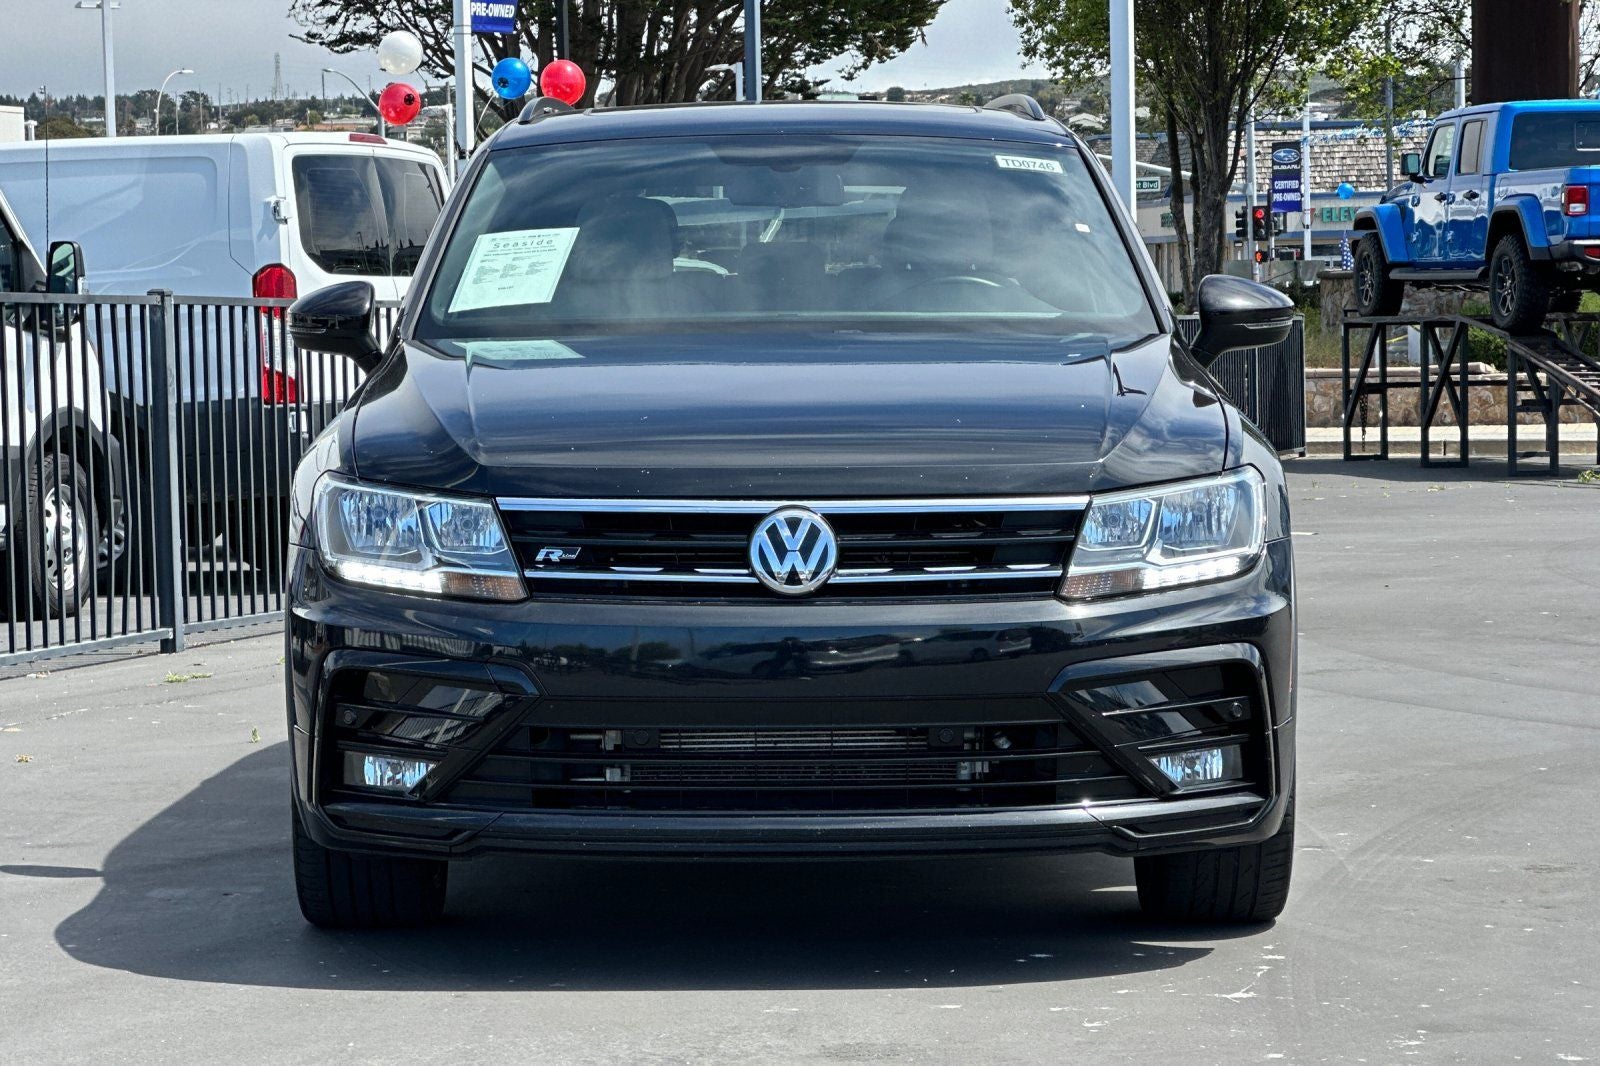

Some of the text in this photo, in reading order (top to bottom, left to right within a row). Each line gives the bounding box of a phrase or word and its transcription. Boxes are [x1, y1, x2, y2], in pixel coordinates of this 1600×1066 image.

[471, 2, 515, 18] PRE-OWNED
[1001, 158, 1055, 171] TD0746
[1142, 181, 1158, 189] Blvd
[1274, 180, 1299, 189] CERTIFIED
[1273, 192, 1301, 202] PRE-OWNED
[492, 239, 554, 249] Seaside
